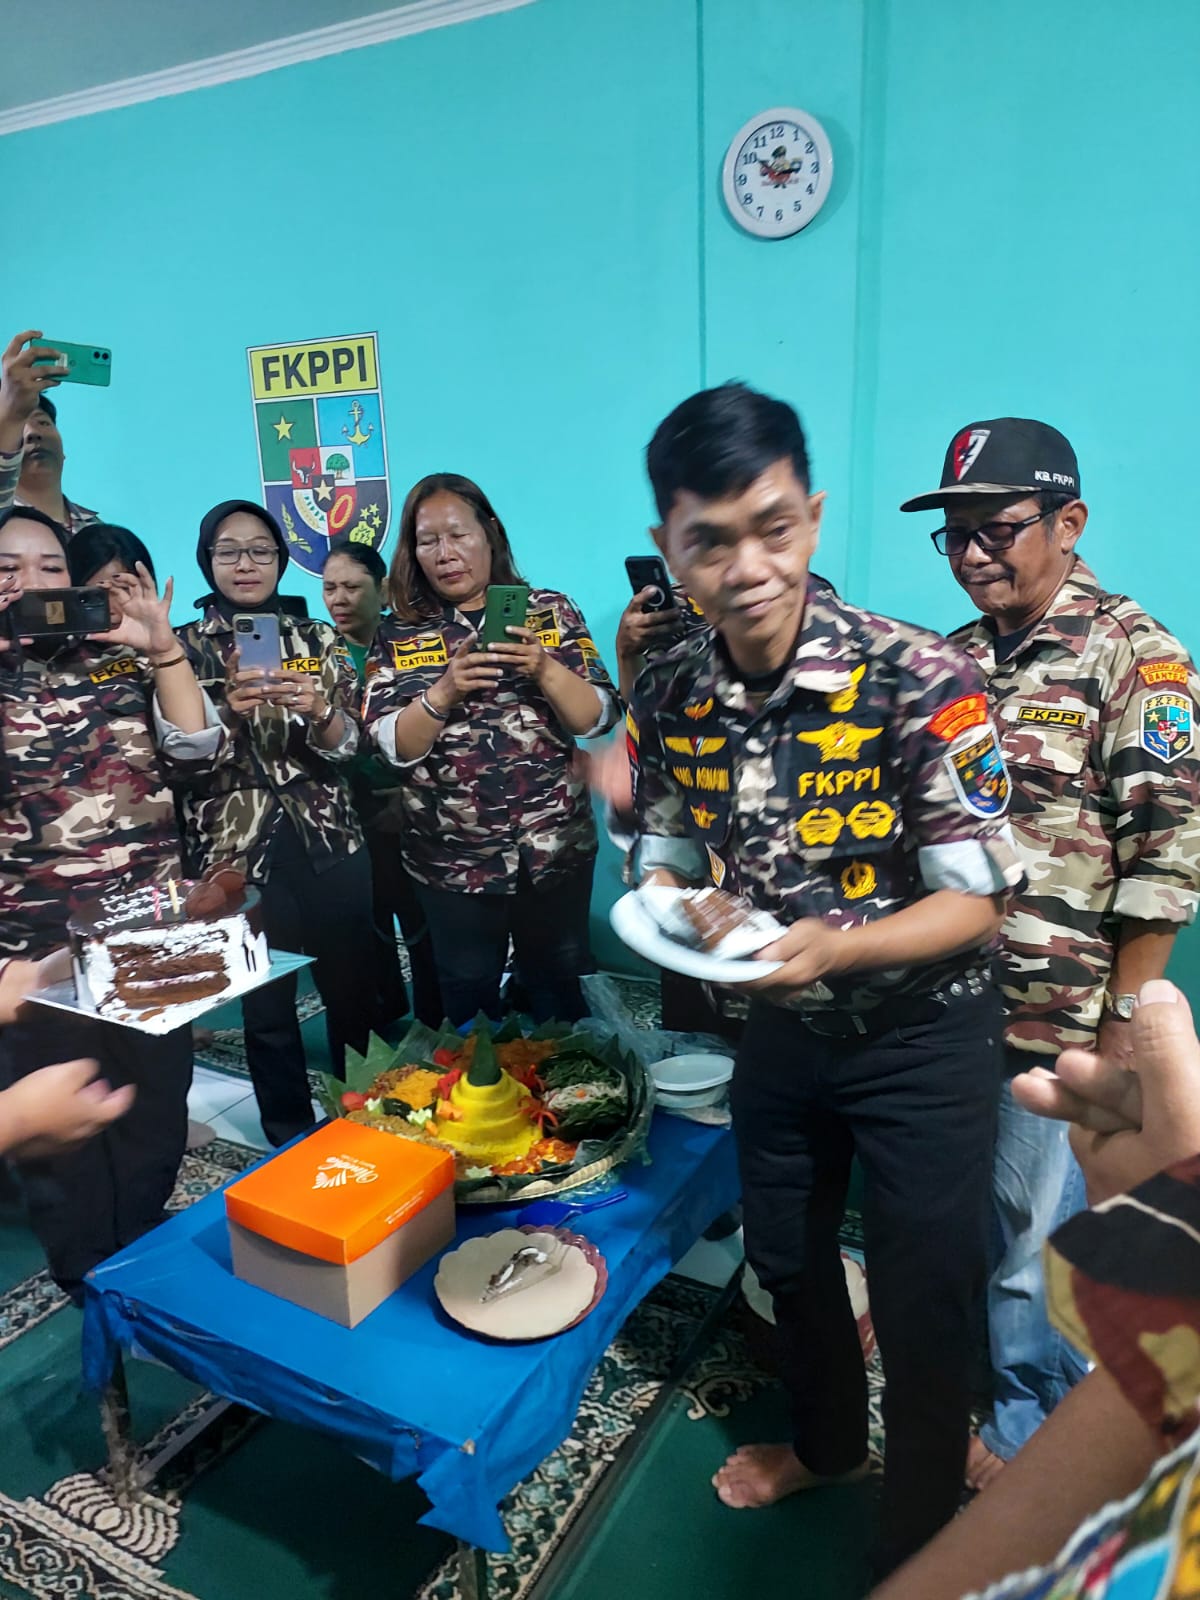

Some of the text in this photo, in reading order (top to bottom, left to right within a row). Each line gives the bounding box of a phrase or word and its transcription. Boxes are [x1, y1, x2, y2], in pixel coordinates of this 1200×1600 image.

[770, 126, 784, 140] 12
[793, 130, 800, 142] 1
[754, 136, 767, 149] 11
[805, 142, 815, 154] 2
[743, 152, 758, 166] 10
[811, 162, 820, 174] 3
[738, 175, 748, 186] 9
[806, 183, 815, 195] 4
[744, 193, 754, 206] 8
[757, 206, 765, 218] 7
[794, 201, 802, 213] 5
[776, 209, 784, 221] 6
[262, 345, 368, 391] FKPPI
[1020, 709, 1083, 725] FKPPI
[797, 765, 881, 798] FKPPI
